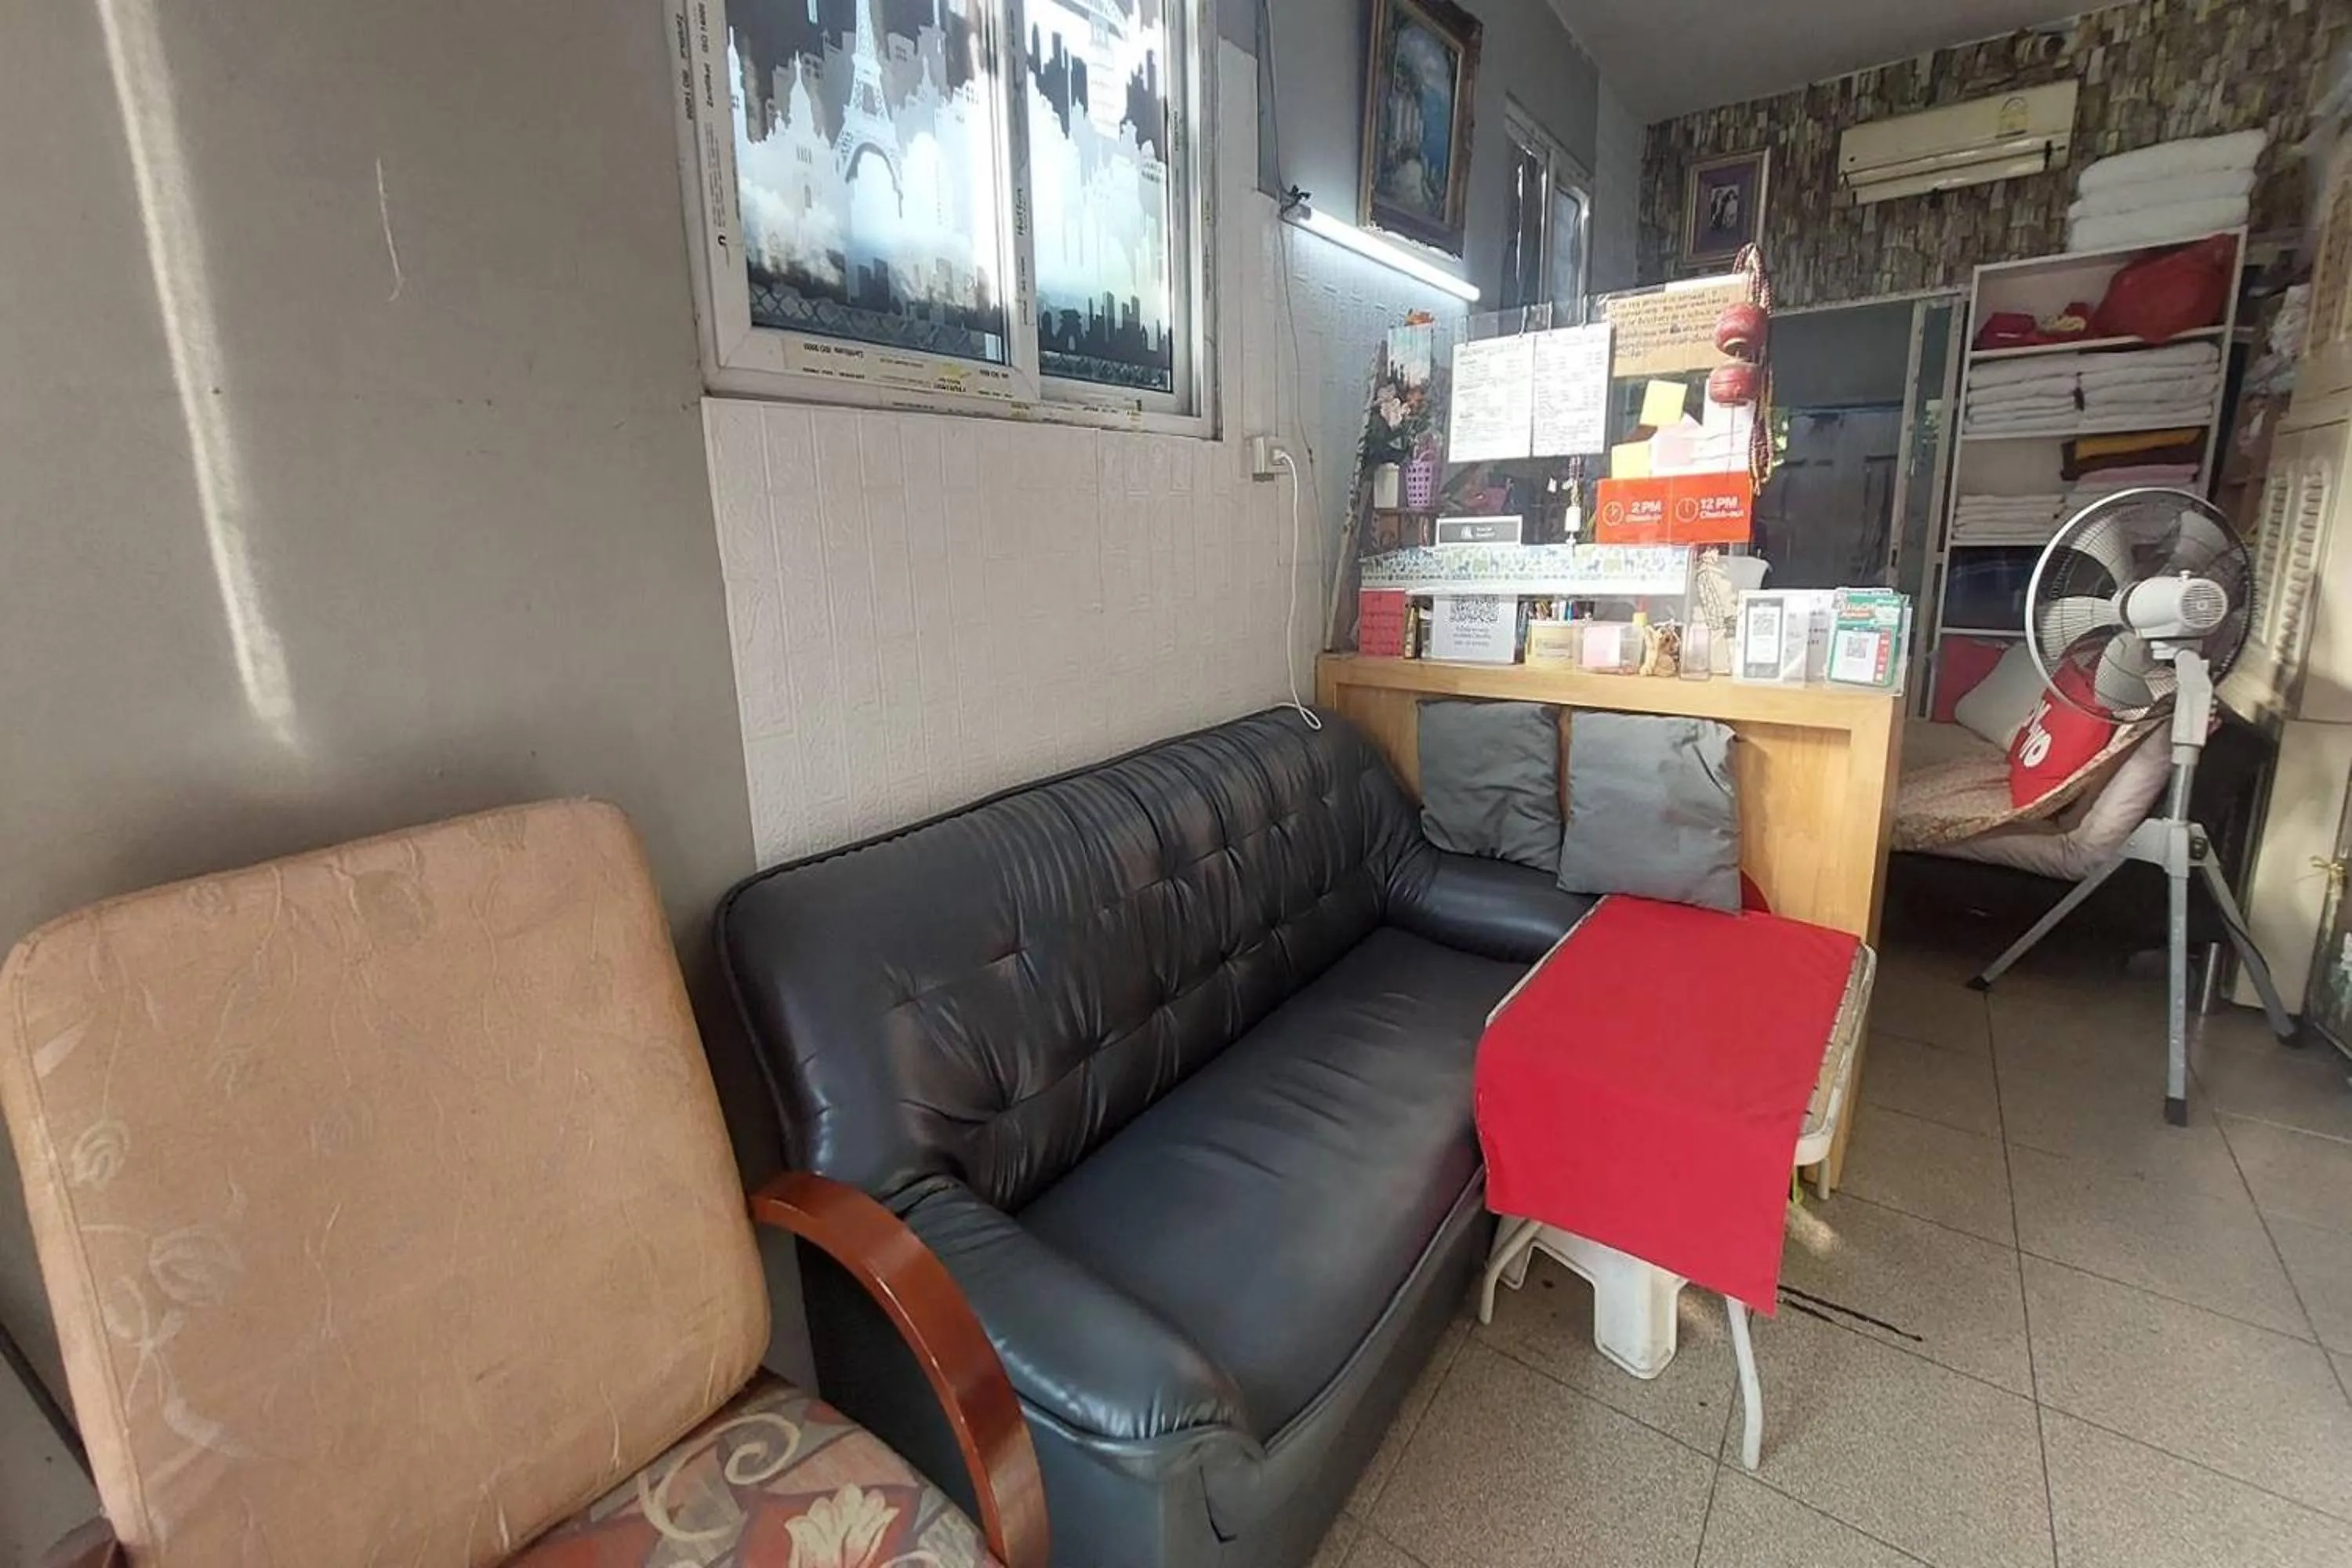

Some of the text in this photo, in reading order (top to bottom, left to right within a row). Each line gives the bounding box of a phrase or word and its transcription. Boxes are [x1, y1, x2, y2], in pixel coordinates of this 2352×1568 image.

[1632, 500, 1662, 514] 2 PM
[1700, 496, 1737, 510] 12 PM
